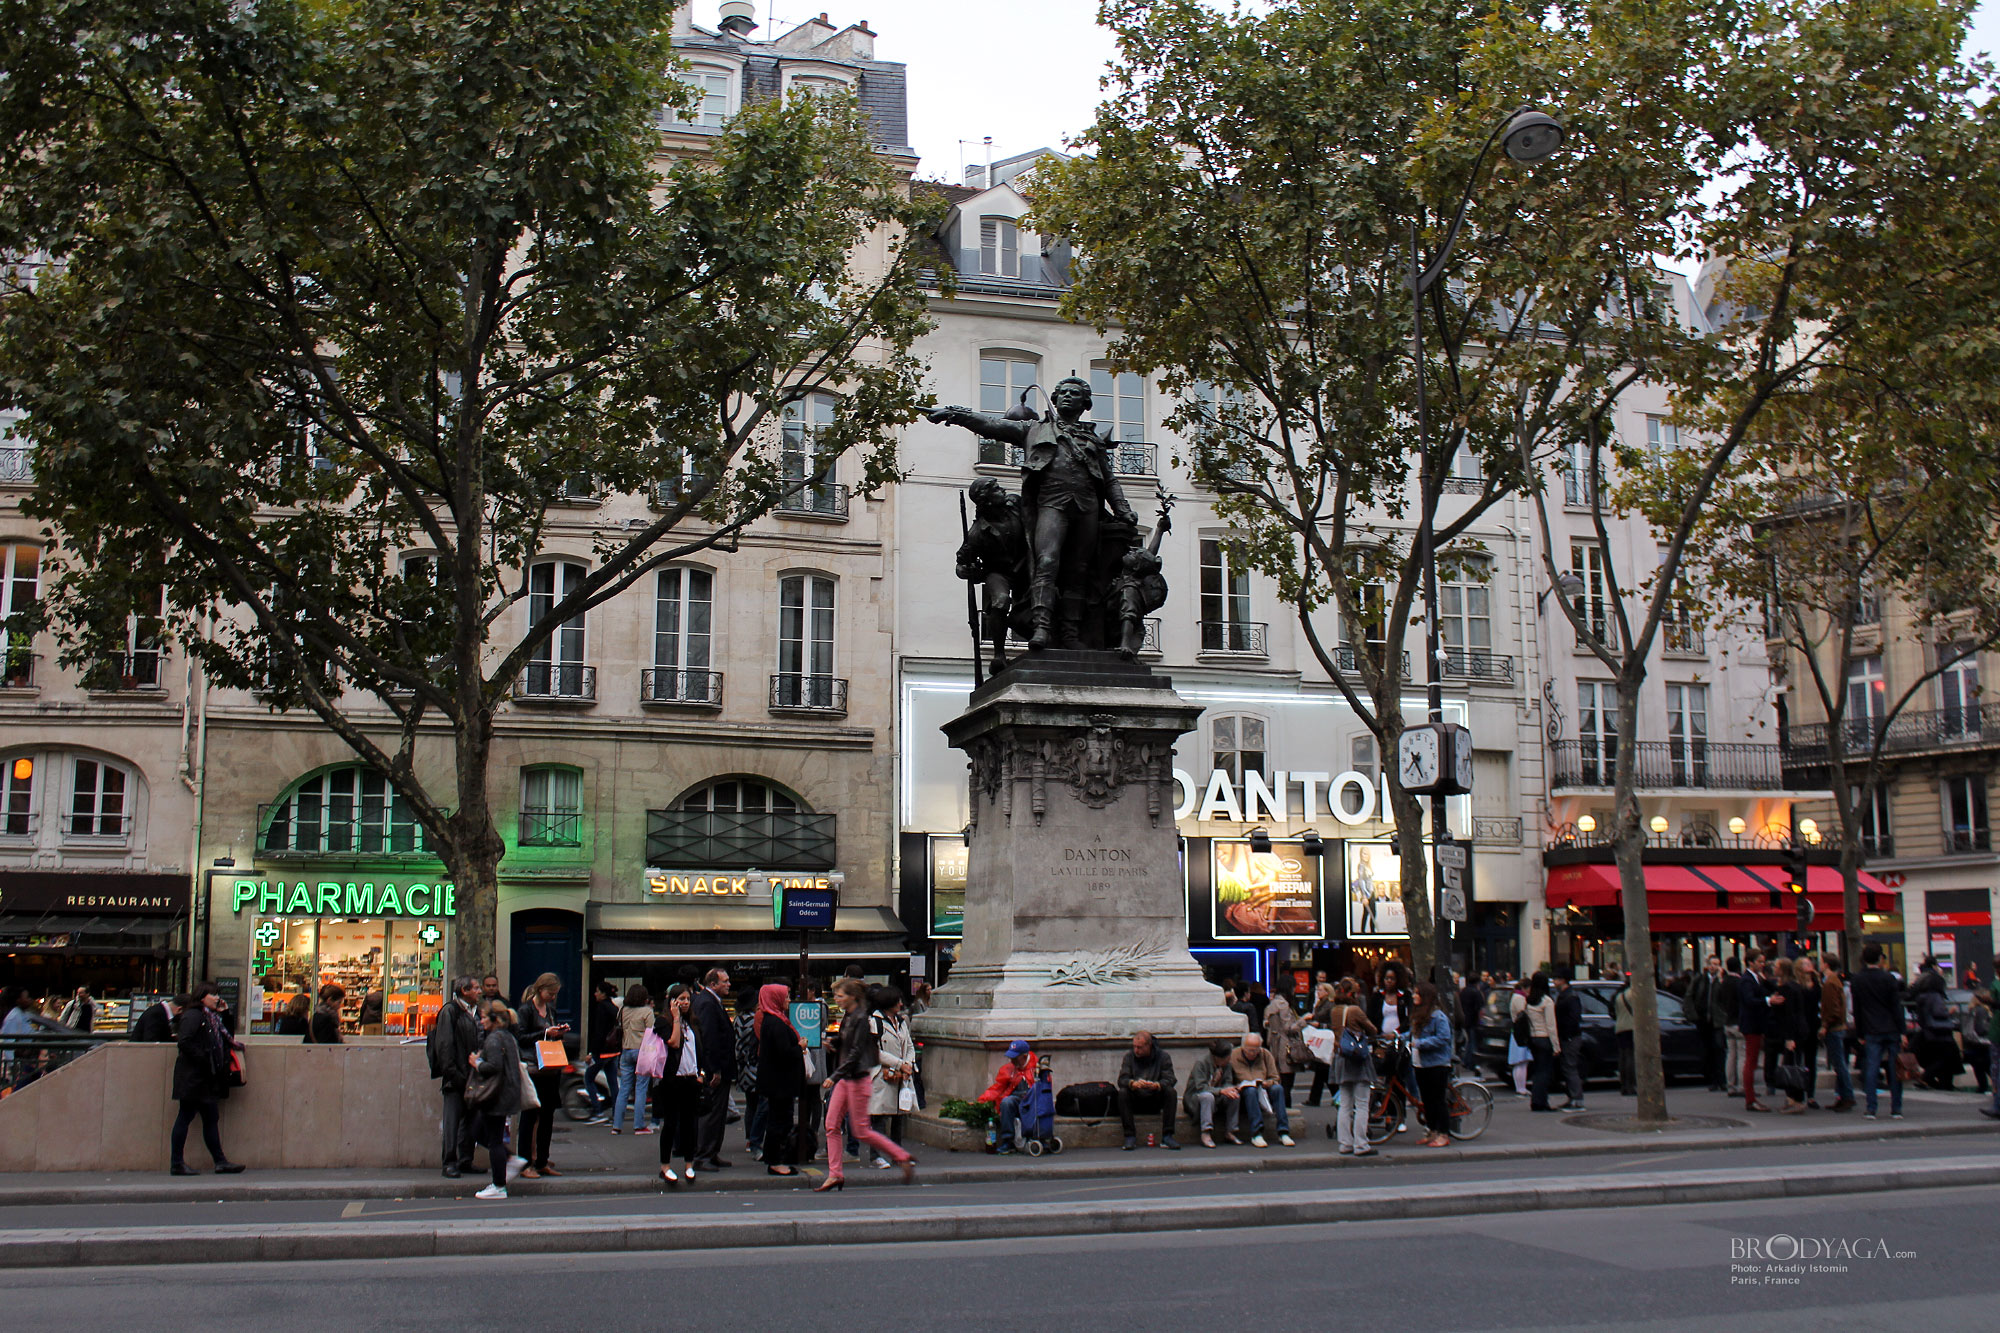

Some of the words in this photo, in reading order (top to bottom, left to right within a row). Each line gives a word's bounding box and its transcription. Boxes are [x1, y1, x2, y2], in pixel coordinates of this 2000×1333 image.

[1173, 768, 1395, 825] DANTO
[1094, 834, 1102, 843] A
[1064, 848, 1132, 861] DANTON
[1051, 867, 1064, 876] LA
[1066, 867, 1098, 877] VILLE
[1101, 867, 1115, 877] DE
[1118, 867, 1148, 877] PARIS
[650, 876, 746, 895] SNACK
[1087, 882, 1111, 892] 1889
[1269, 881, 1312, 894] DHEEPAN
[67, 895, 172, 907] RESTAURANT
[233, 880, 457, 916] PHARMACIE
[788, 900, 830, 909] Saint-Germain
[799, 909, 818, 917] Odéon
[799, 1008, 820, 1020] BUS
